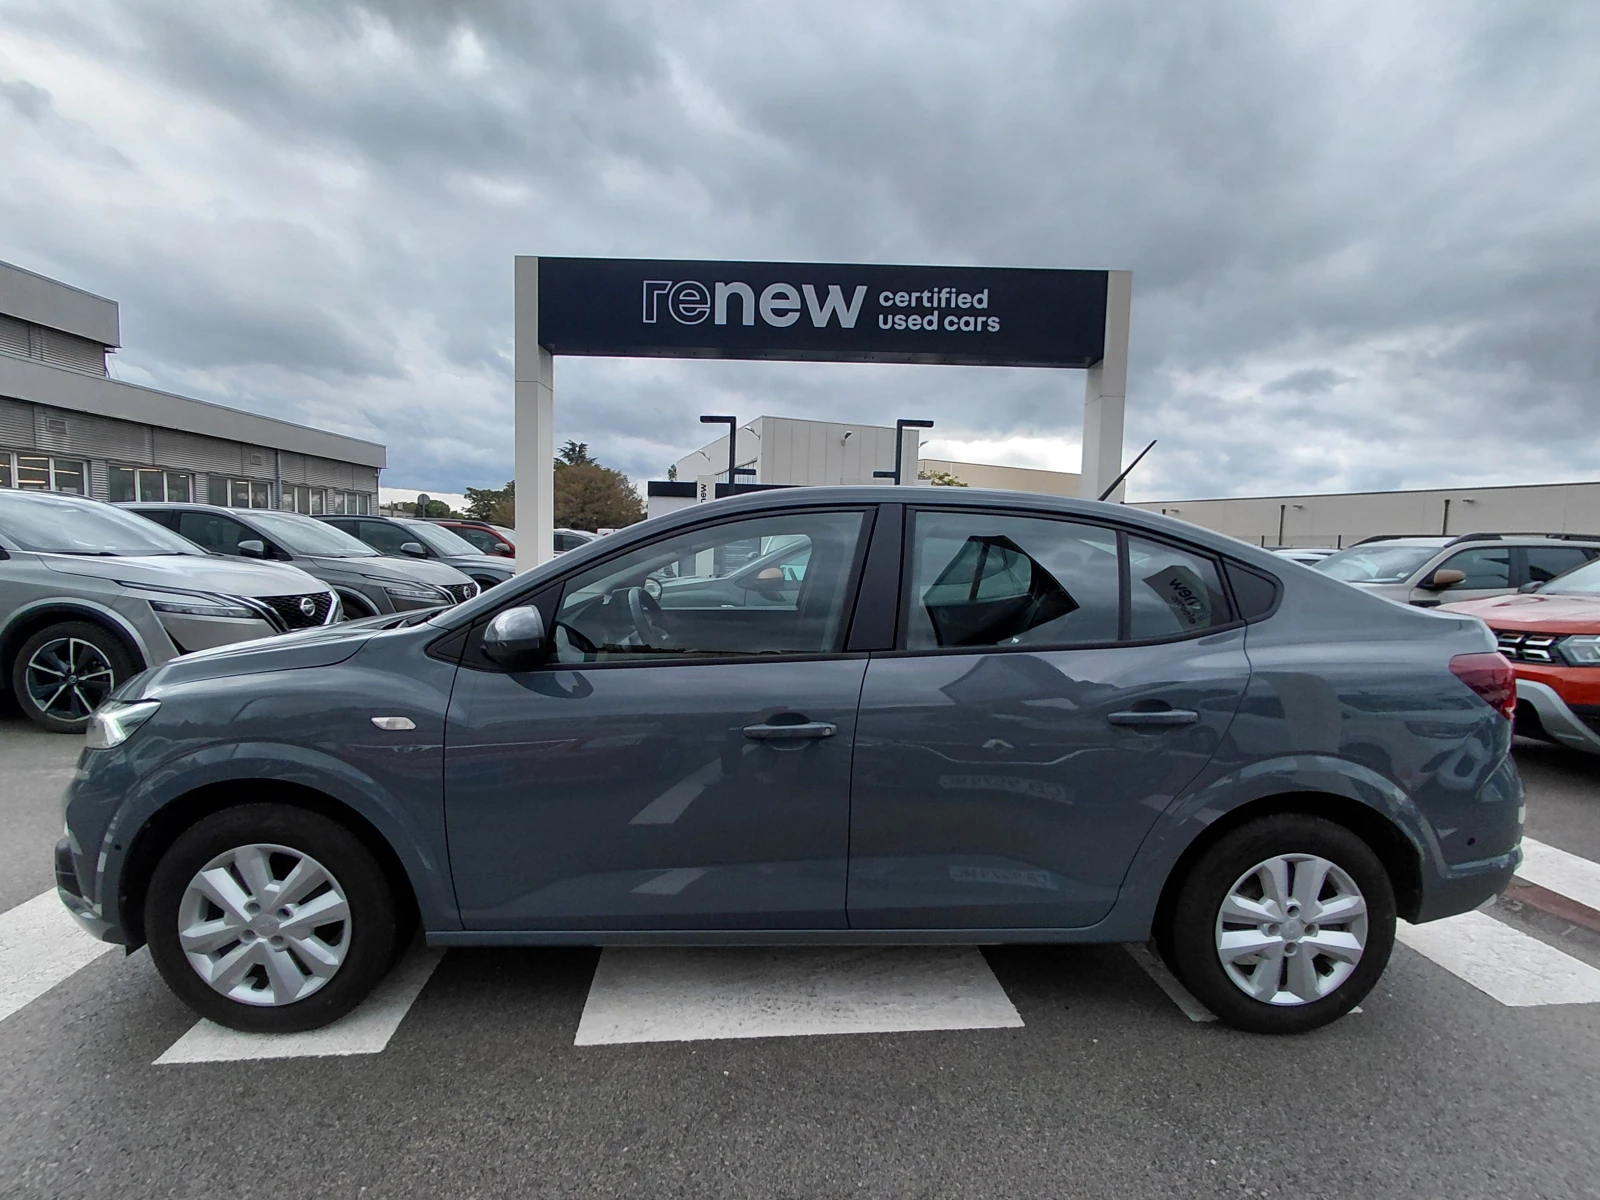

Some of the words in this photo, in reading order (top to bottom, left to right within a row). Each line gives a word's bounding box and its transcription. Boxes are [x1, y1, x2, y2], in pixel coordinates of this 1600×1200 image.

[642, 279, 868, 329] renew
[878, 287, 990, 310] certified
[877, 310, 939, 332] used
[943, 314, 1001, 333] cars
